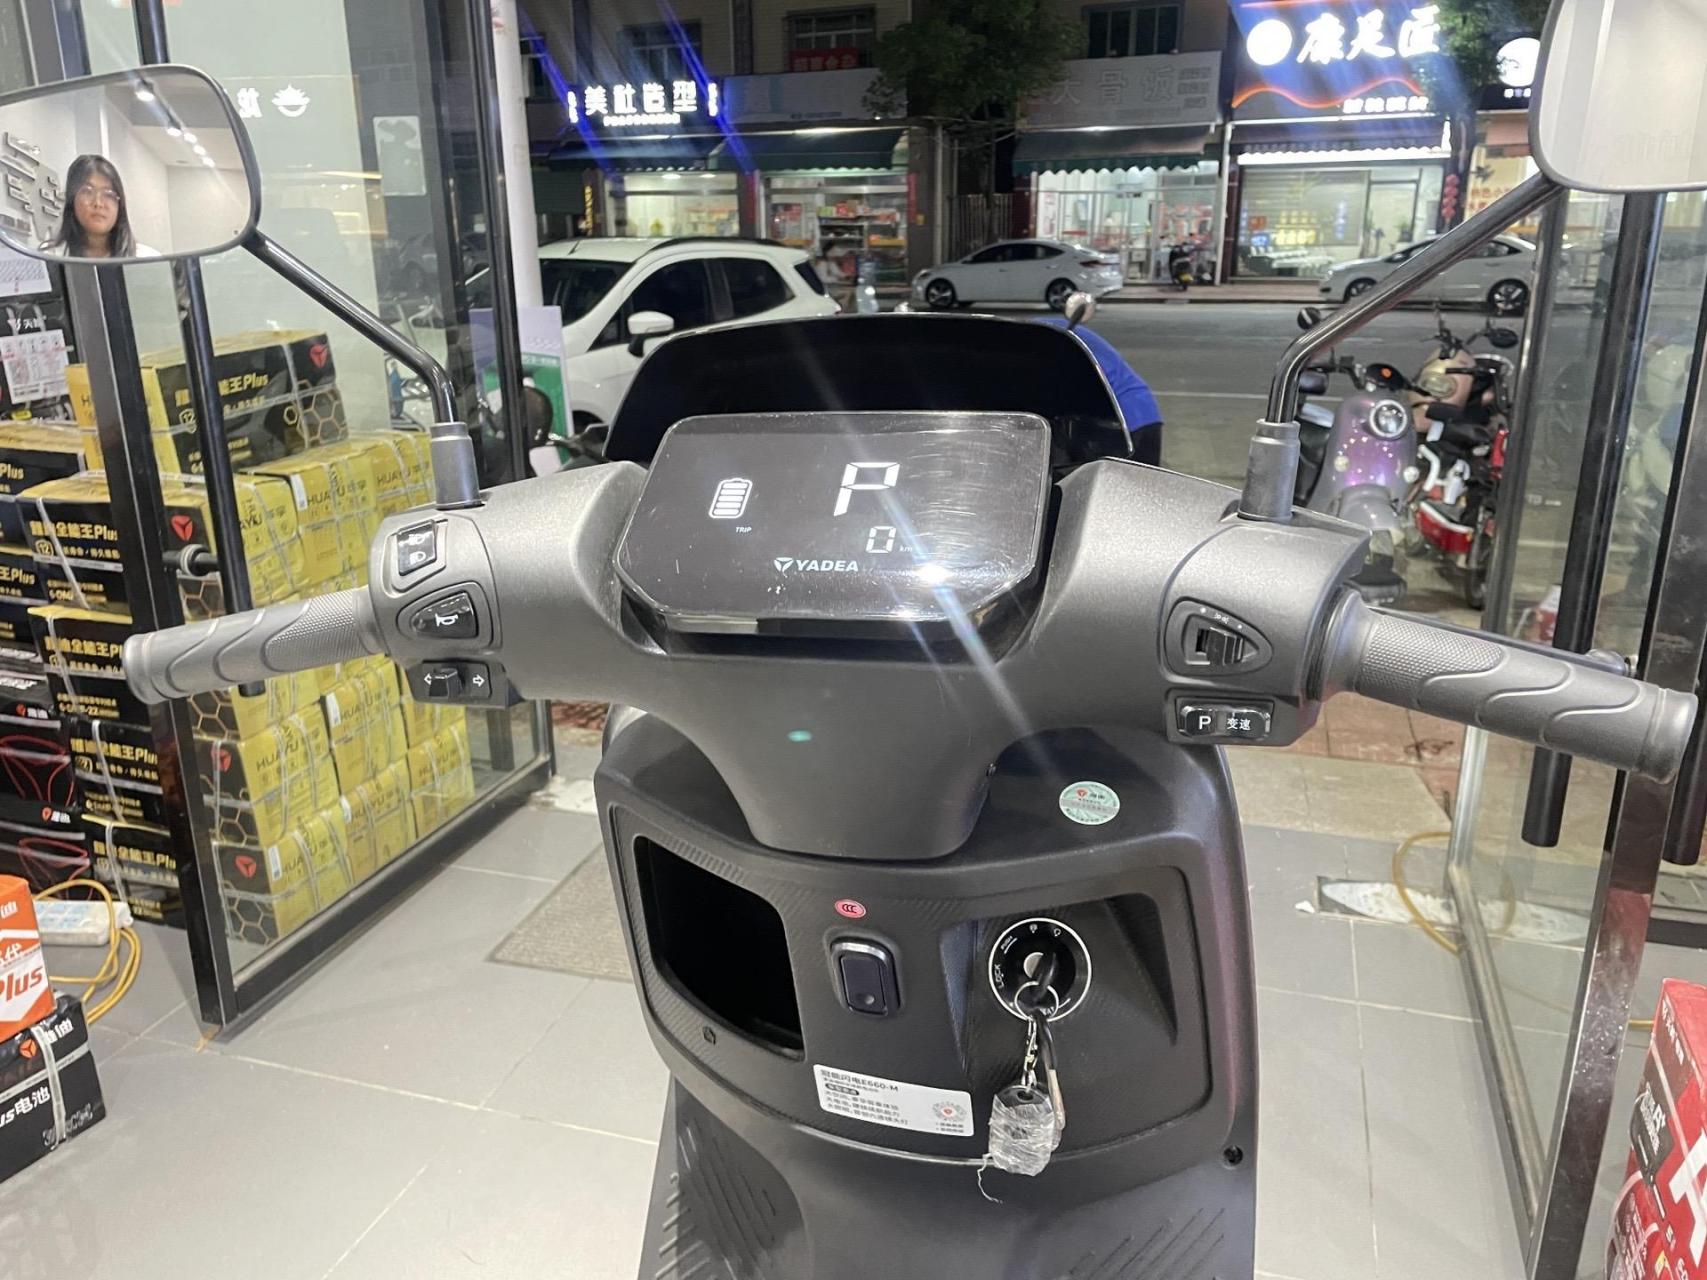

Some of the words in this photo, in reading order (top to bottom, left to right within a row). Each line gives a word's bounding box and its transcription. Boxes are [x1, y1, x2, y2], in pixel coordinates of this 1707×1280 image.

[307, 486, 345, 505] HUAU
[834, 461, 900, 517] P
[735, 526, 752, 534] TRIP
[866, 526, 897, 554] 0
[794, 559, 859, 573] YADEA
[1199, 716, 1212, 730] P
